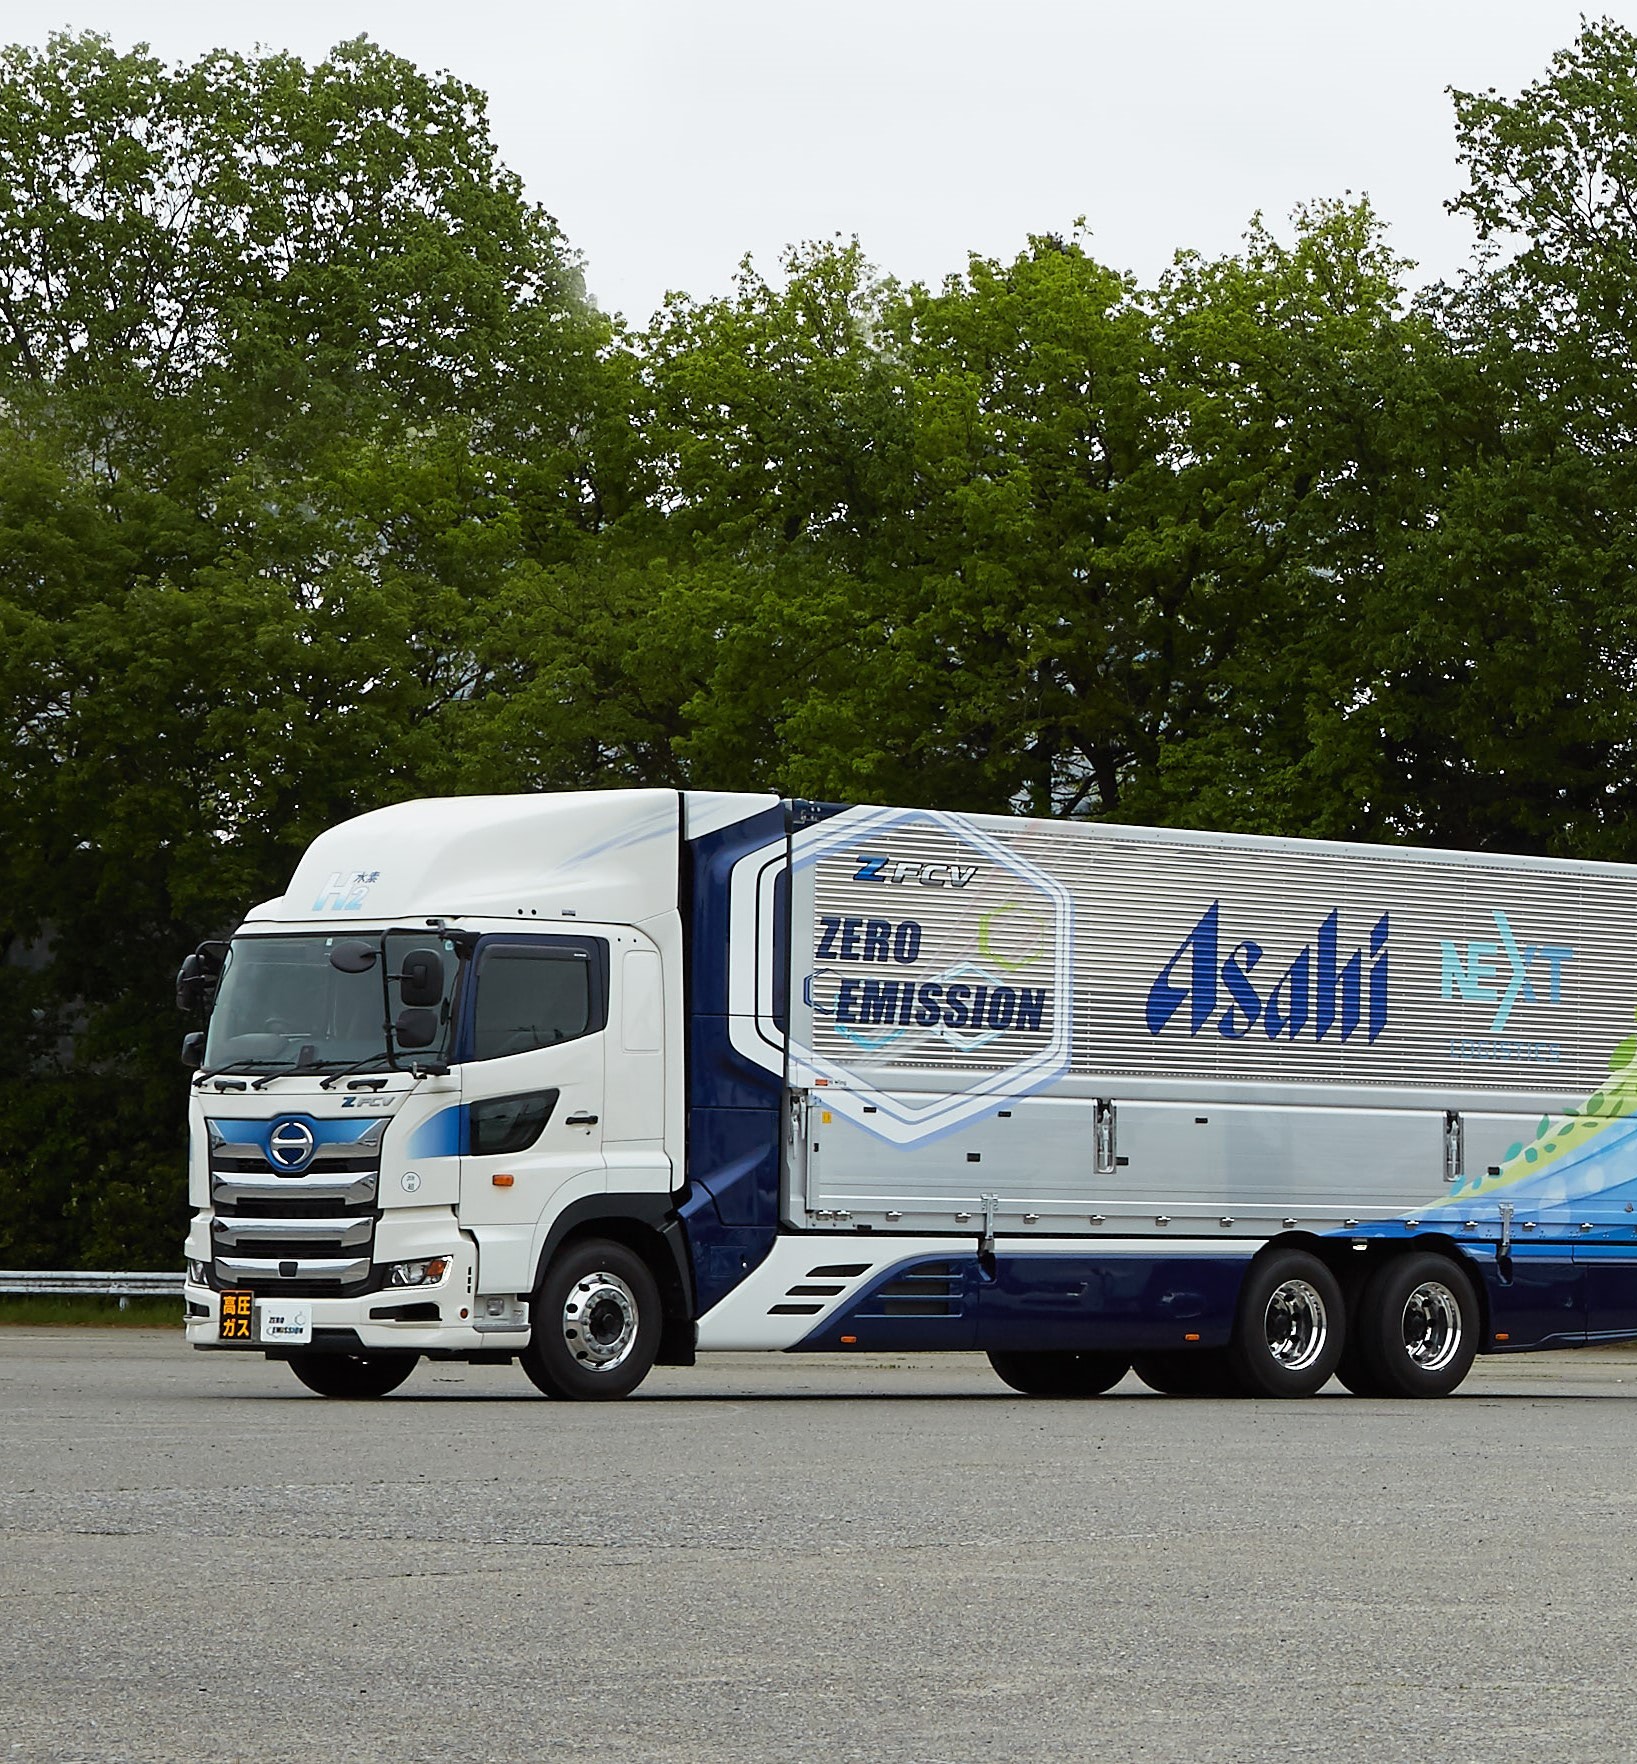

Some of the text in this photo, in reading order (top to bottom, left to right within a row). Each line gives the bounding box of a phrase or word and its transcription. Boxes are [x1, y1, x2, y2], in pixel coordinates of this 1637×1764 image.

[815, 916, 922, 964] ZERO
[1146, 899, 1390, 1046] Asahi
[1440, 910, 1574, 1032] NEXT
[835, 977, 1046, 1031] EMISSION
[1450, 1039, 1560, 1062] LOGISTICS
[222, 1318, 250, 1337] ガス
[223, 1296, 251, 1315] 高圧
